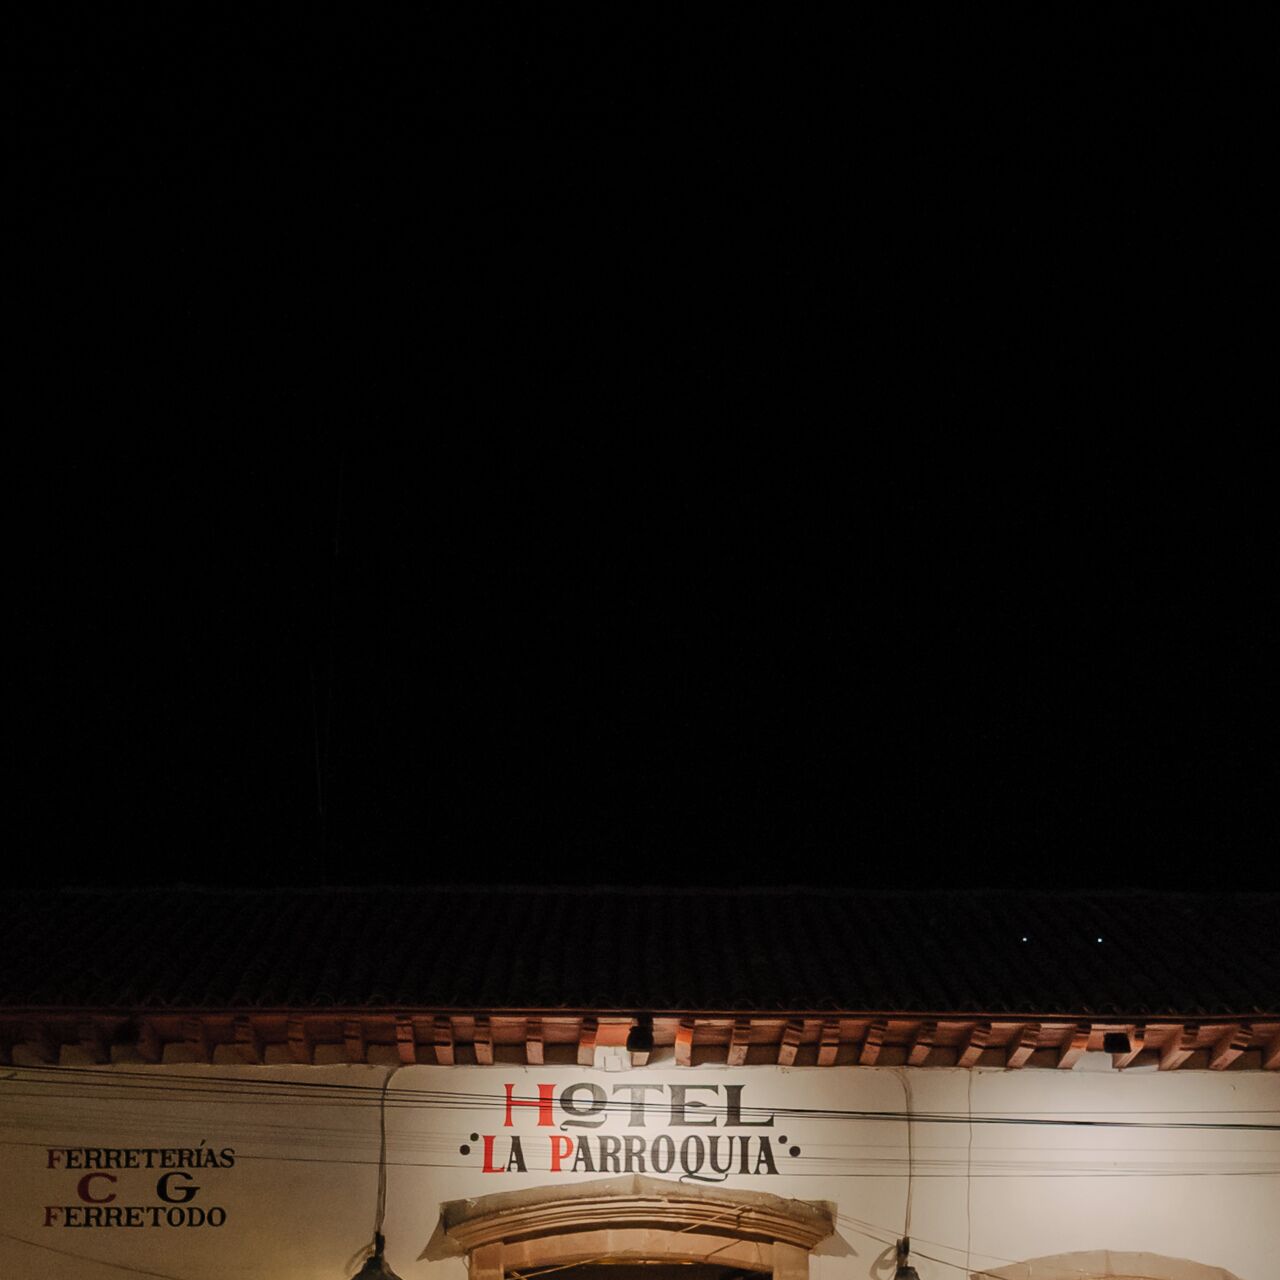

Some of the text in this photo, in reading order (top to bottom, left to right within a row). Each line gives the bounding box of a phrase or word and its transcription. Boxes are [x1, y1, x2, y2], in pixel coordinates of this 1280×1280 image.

[504, 1082, 775, 1131] HOTEL
[47, 1139, 235, 1169] FERRETERÍAS
[482, 1134, 780, 1182] LA PARROQUIA
[77, 1171, 200, 1203] C G
[43, 1206, 226, 1228] FERRETODO
